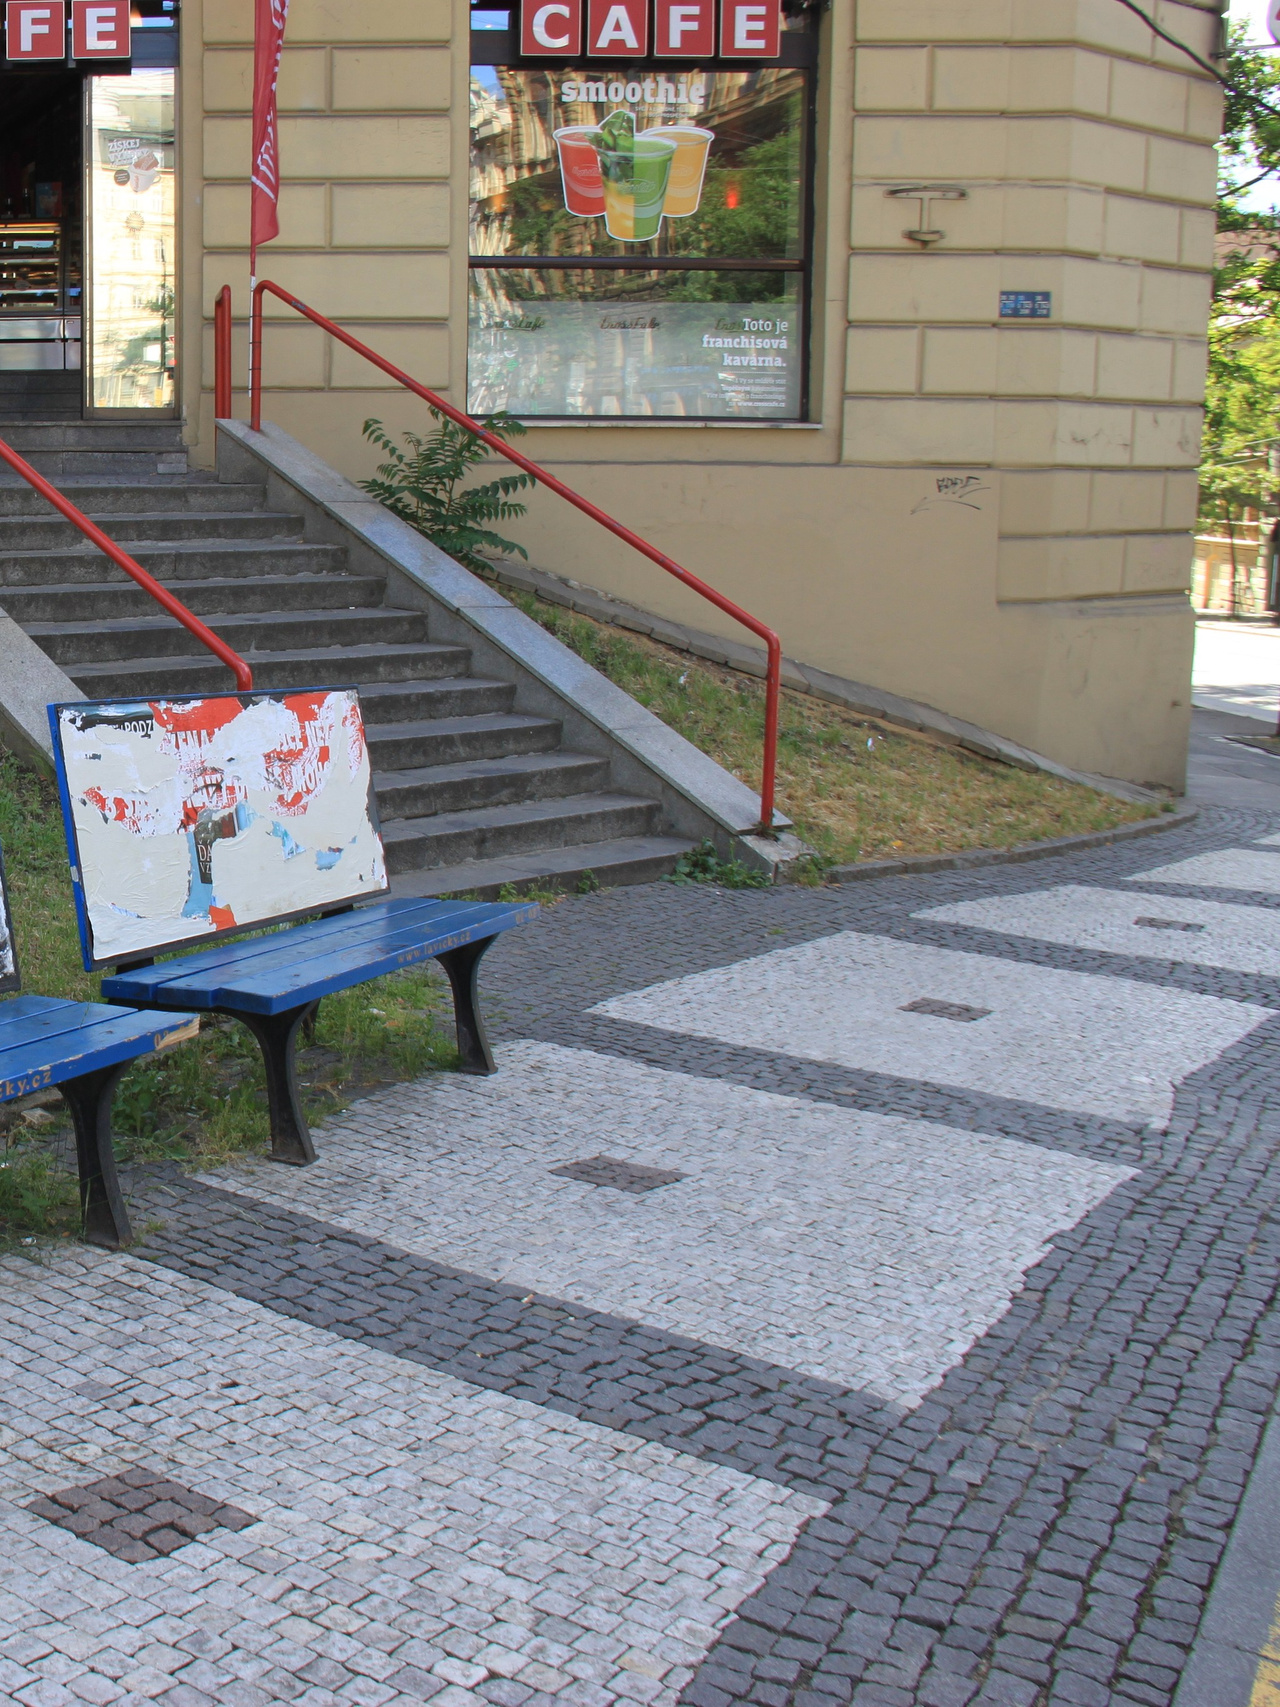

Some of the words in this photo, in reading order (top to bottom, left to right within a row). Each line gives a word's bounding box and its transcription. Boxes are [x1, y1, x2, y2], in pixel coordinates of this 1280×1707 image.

[532, 4, 766, 49] CAFE
[561, 76, 705, 104] smoothie
[108, 139, 140, 151] ZÍSKEJ
[742, 318, 772, 332] Toto
[775, 319, 789, 334] je
[702, 335, 788, 349] franchisová
[723, 352, 787, 367] kavárna.
